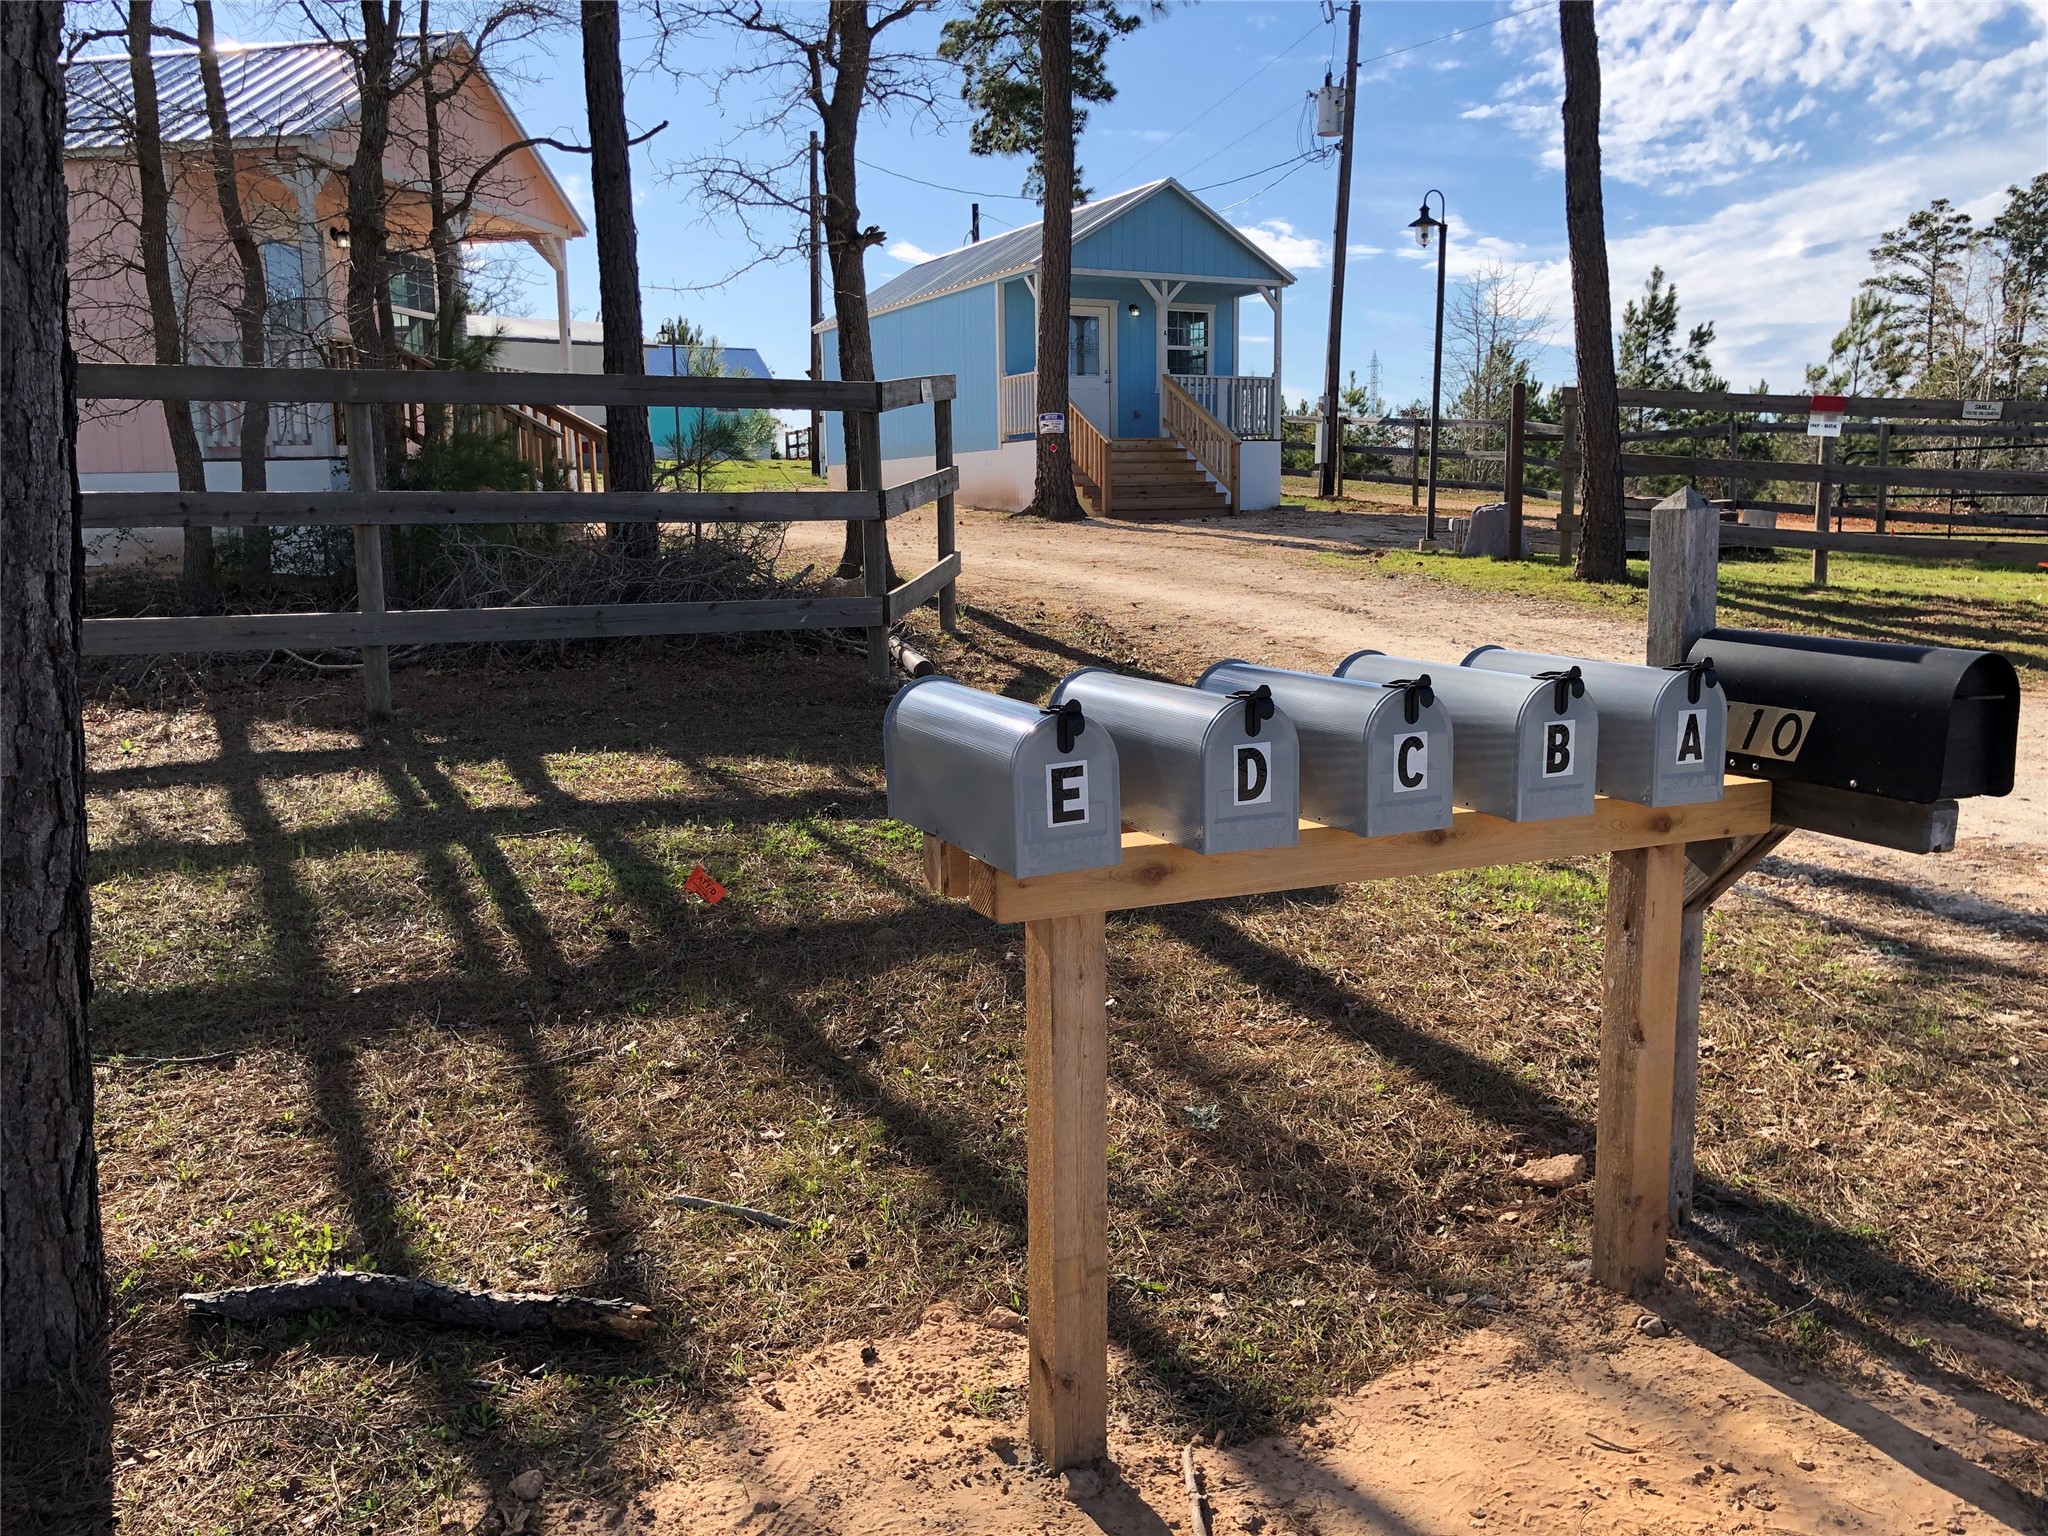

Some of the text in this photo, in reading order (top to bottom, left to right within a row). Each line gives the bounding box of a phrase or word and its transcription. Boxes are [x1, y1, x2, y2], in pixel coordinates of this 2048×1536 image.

[1545, 723, 1570, 774] B
[1677, 713, 1703, 762] A
[1727, 705, 1802, 757] 10
[1238, 747, 1268, 802] D
[1397, 736, 1424, 788] C
[1051, 765, 1085, 824] E
